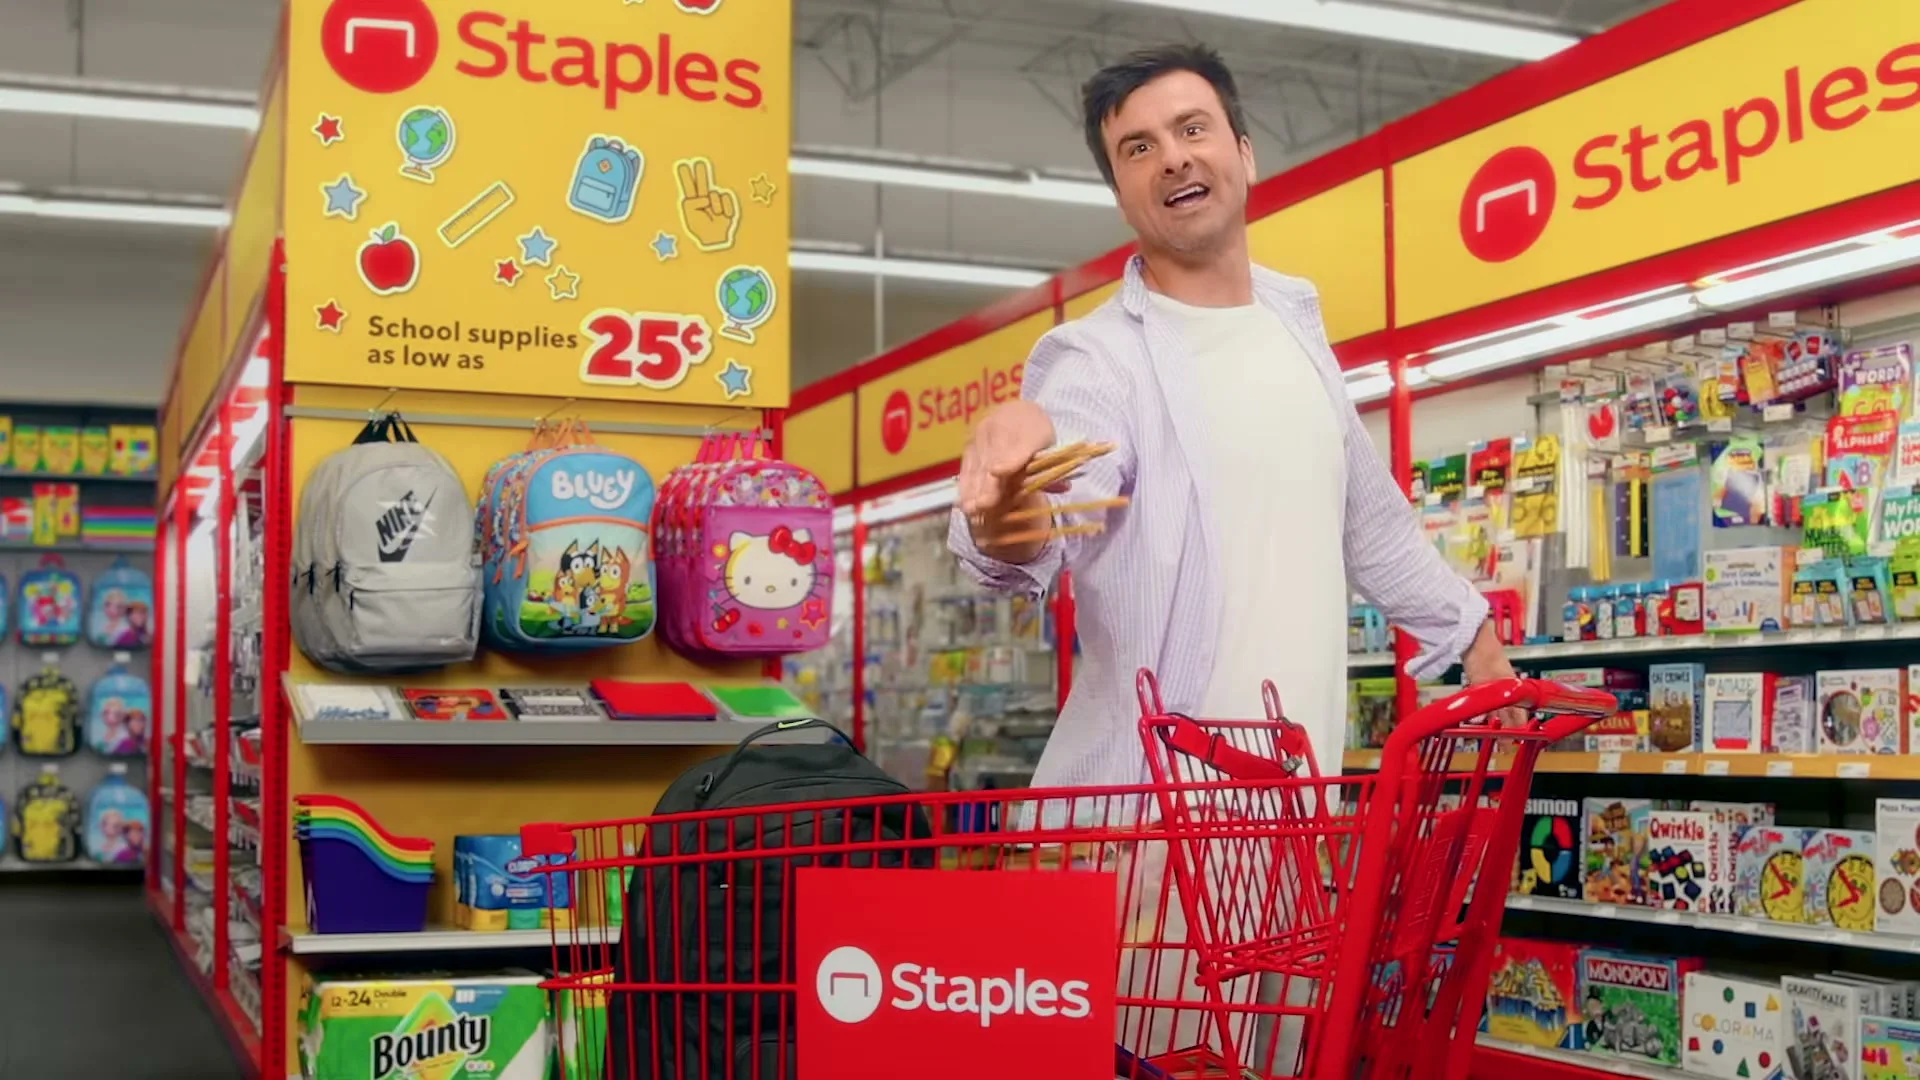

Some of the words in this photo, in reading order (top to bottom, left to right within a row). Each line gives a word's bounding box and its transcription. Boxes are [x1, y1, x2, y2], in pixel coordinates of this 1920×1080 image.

[456, 11, 763, 110] Staples
[1572, 42, 1920, 210] Staples
[368, 316, 460, 344] School
[468, 324, 579, 352] supplies
[586, 315, 704, 382] 25¢
[367, 348, 395, 366] as
[403, 346, 450, 369] low
[456, 353, 485, 371] as
[916, 363, 1023, 430] Staples
[551, 469, 636, 510] BLUEY
[375, 489, 422, 547] NIKE
[1884, 500, 1906, 520] My
[1884, 519, 1920, 539] WO
[1524, 798, 1578, 817] simon
[1651, 817, 1705, 842] Qwirkle
[1588, 960, 1669, 988] MONOPOLY
[1786, 983, 1822, 1000] GRAVITY
[891, 962, 1091, 1027] Staples
[1692, 1012, 1775, 1042] COLORAMA
[373, 1012, 488, 1080] Bounty
